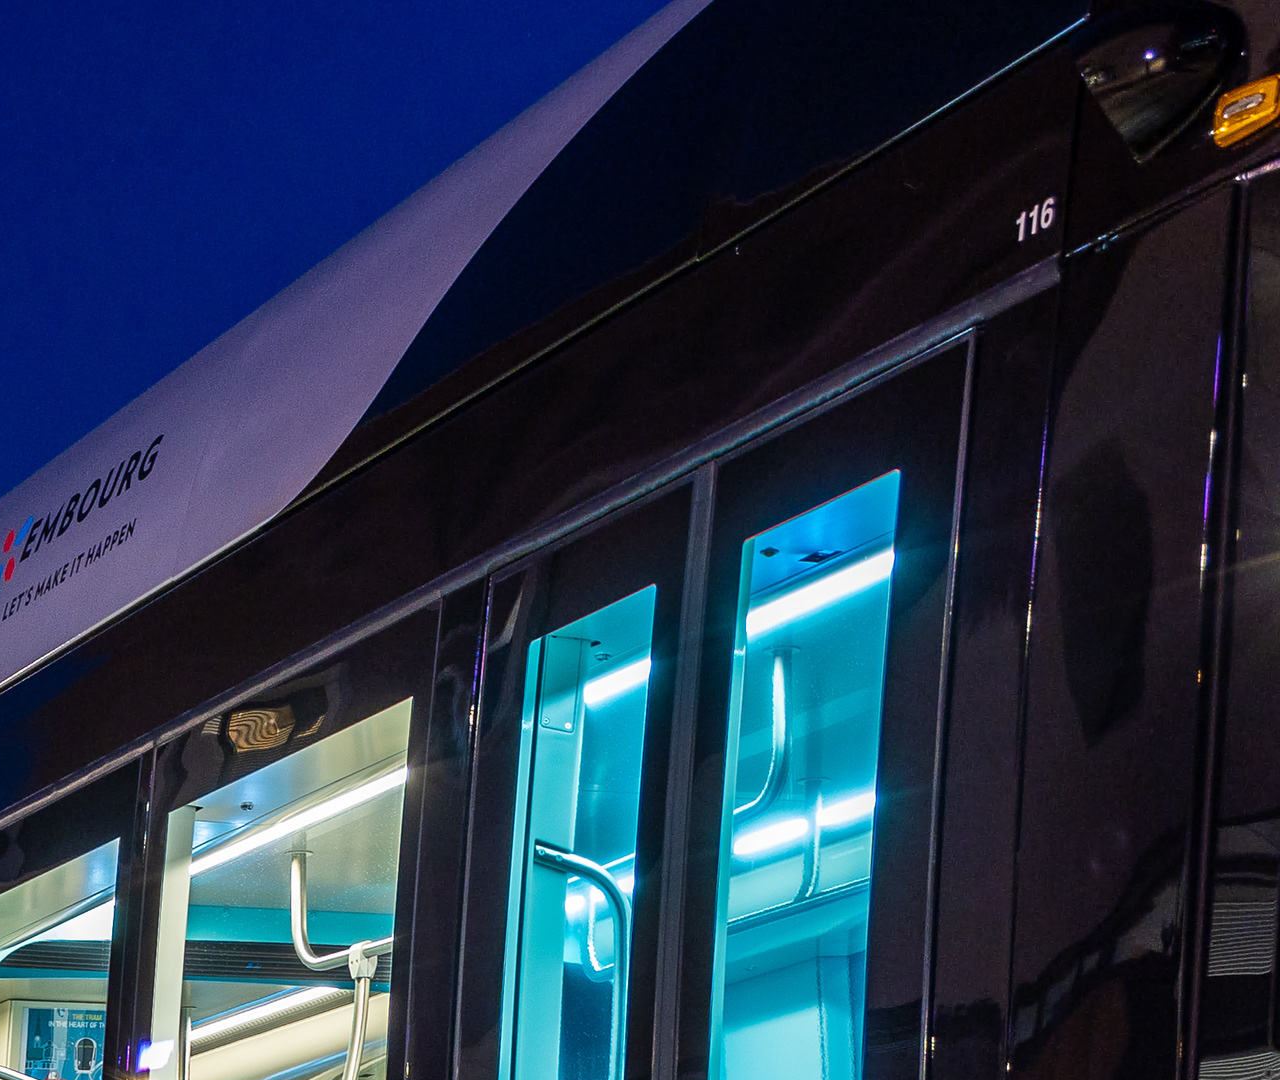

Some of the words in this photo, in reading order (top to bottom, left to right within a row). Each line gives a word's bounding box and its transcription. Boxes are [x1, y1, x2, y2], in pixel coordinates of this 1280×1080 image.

[1015, 196, 1056, 242] 116
[1, 586, 34, 622] LET'S
[34, 563, 70, 600] MAKE
[69, 553, 85, 578] IT
[84, 518, 138, 568] HAPPEN
[69, 1021, 88, 1029] HEART
